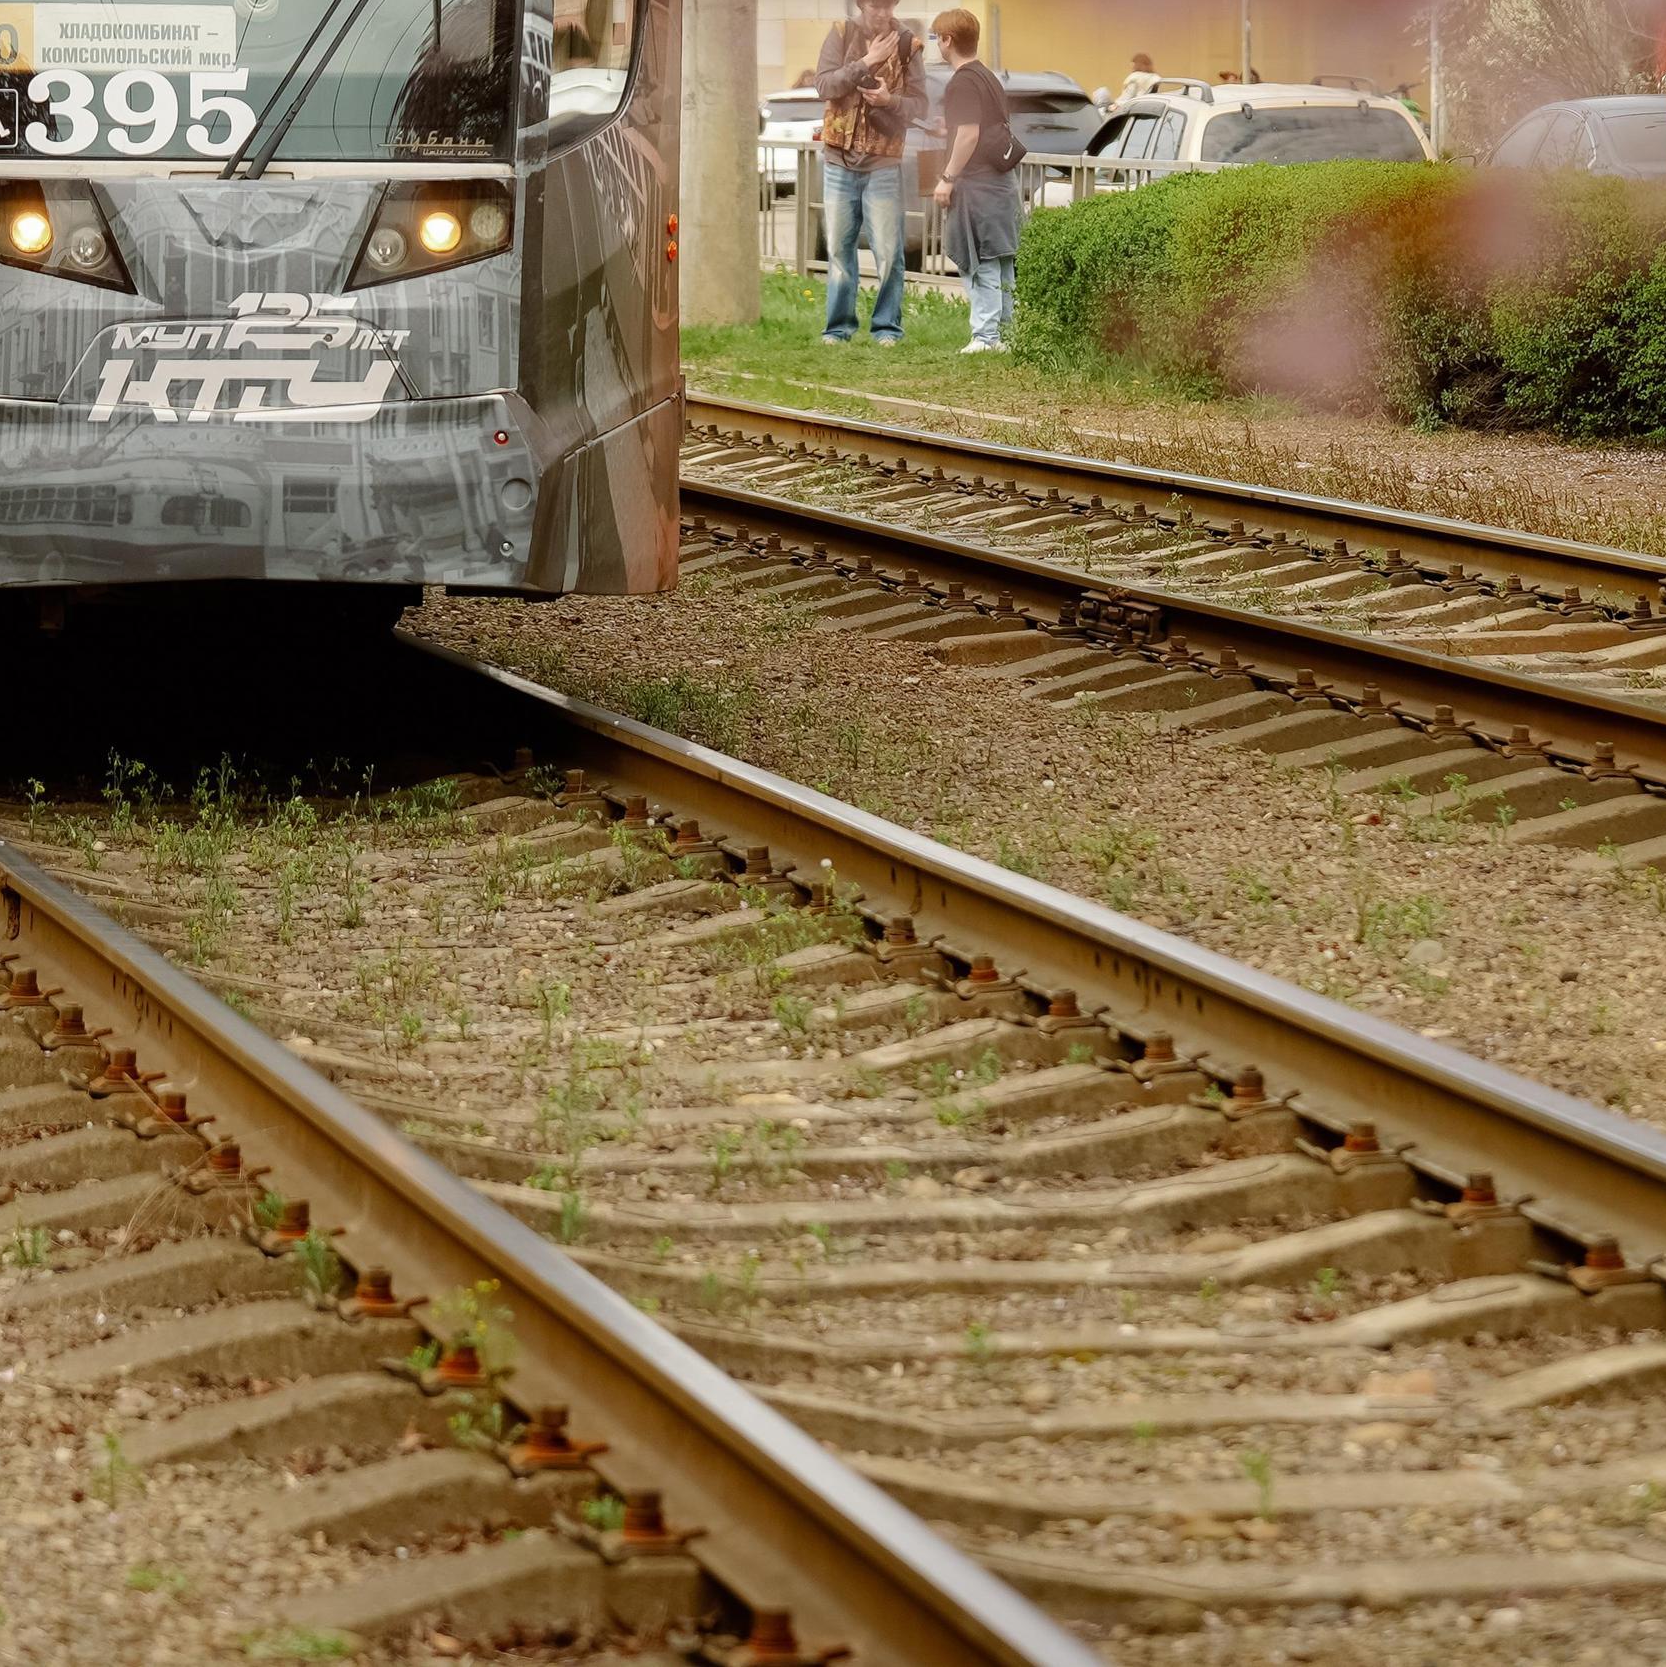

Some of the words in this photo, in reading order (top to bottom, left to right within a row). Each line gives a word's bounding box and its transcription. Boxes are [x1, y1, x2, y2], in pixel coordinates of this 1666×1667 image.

[59, 22, 201, 41] ХЛАДОКОМБИНАТ
[41, 46, 192, 65] КОМСОМОЛЬСКИЙ
[25, 67, 257, 156] 395
